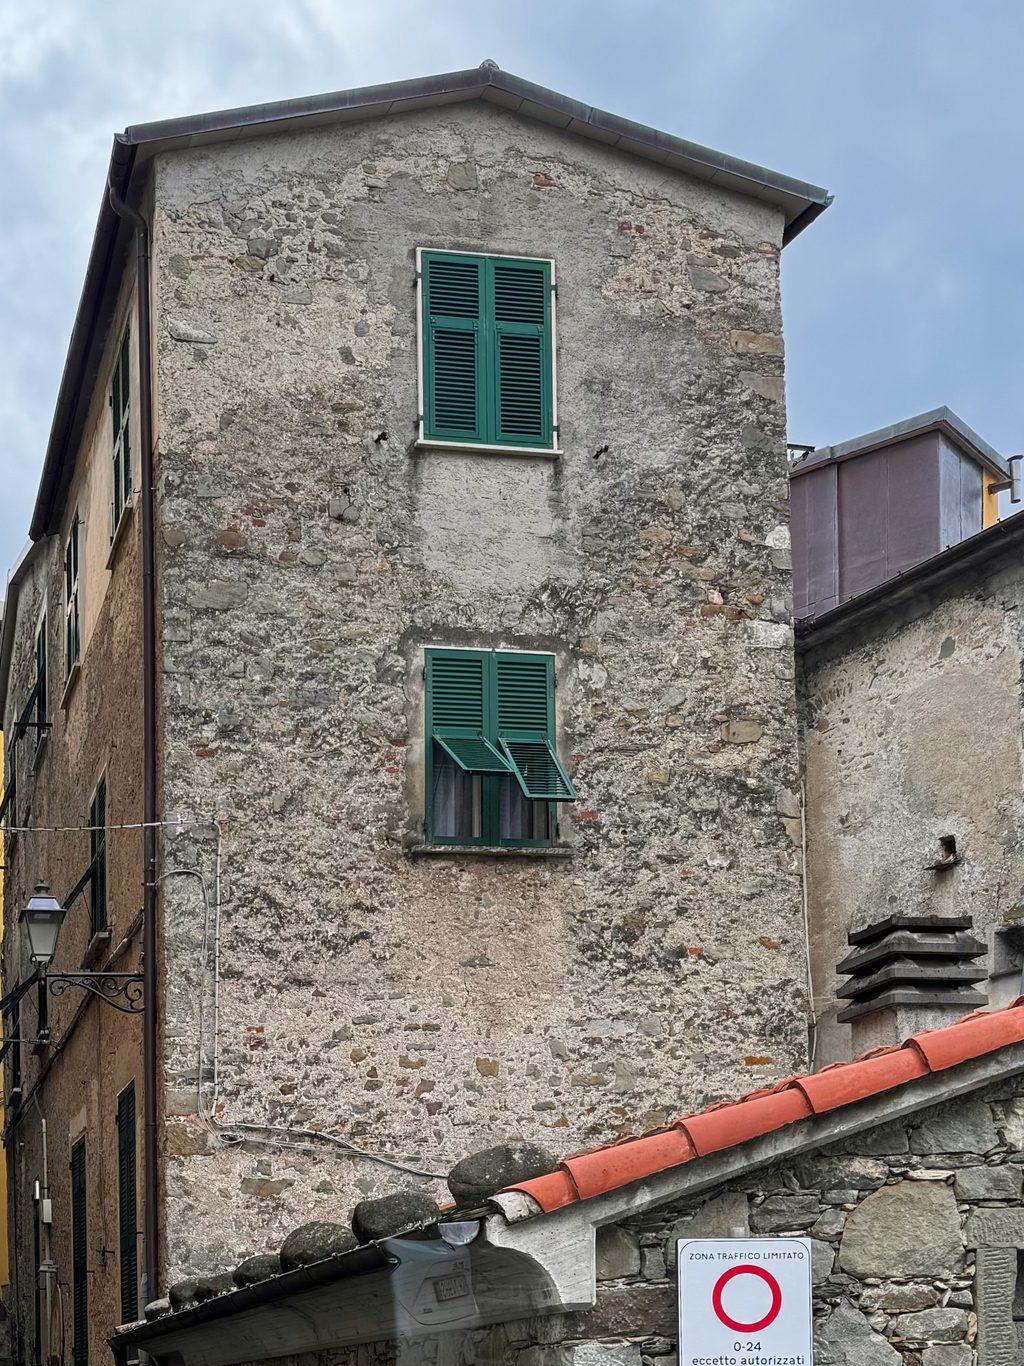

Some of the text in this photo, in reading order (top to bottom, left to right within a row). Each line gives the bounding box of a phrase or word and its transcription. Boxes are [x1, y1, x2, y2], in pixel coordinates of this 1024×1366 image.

[717, 1252, 760, 1260] TRAFFICO
[733, 1342, 762, 1351] 0-24
[692, 1356, 805, 1366] eccetto autorizzati
